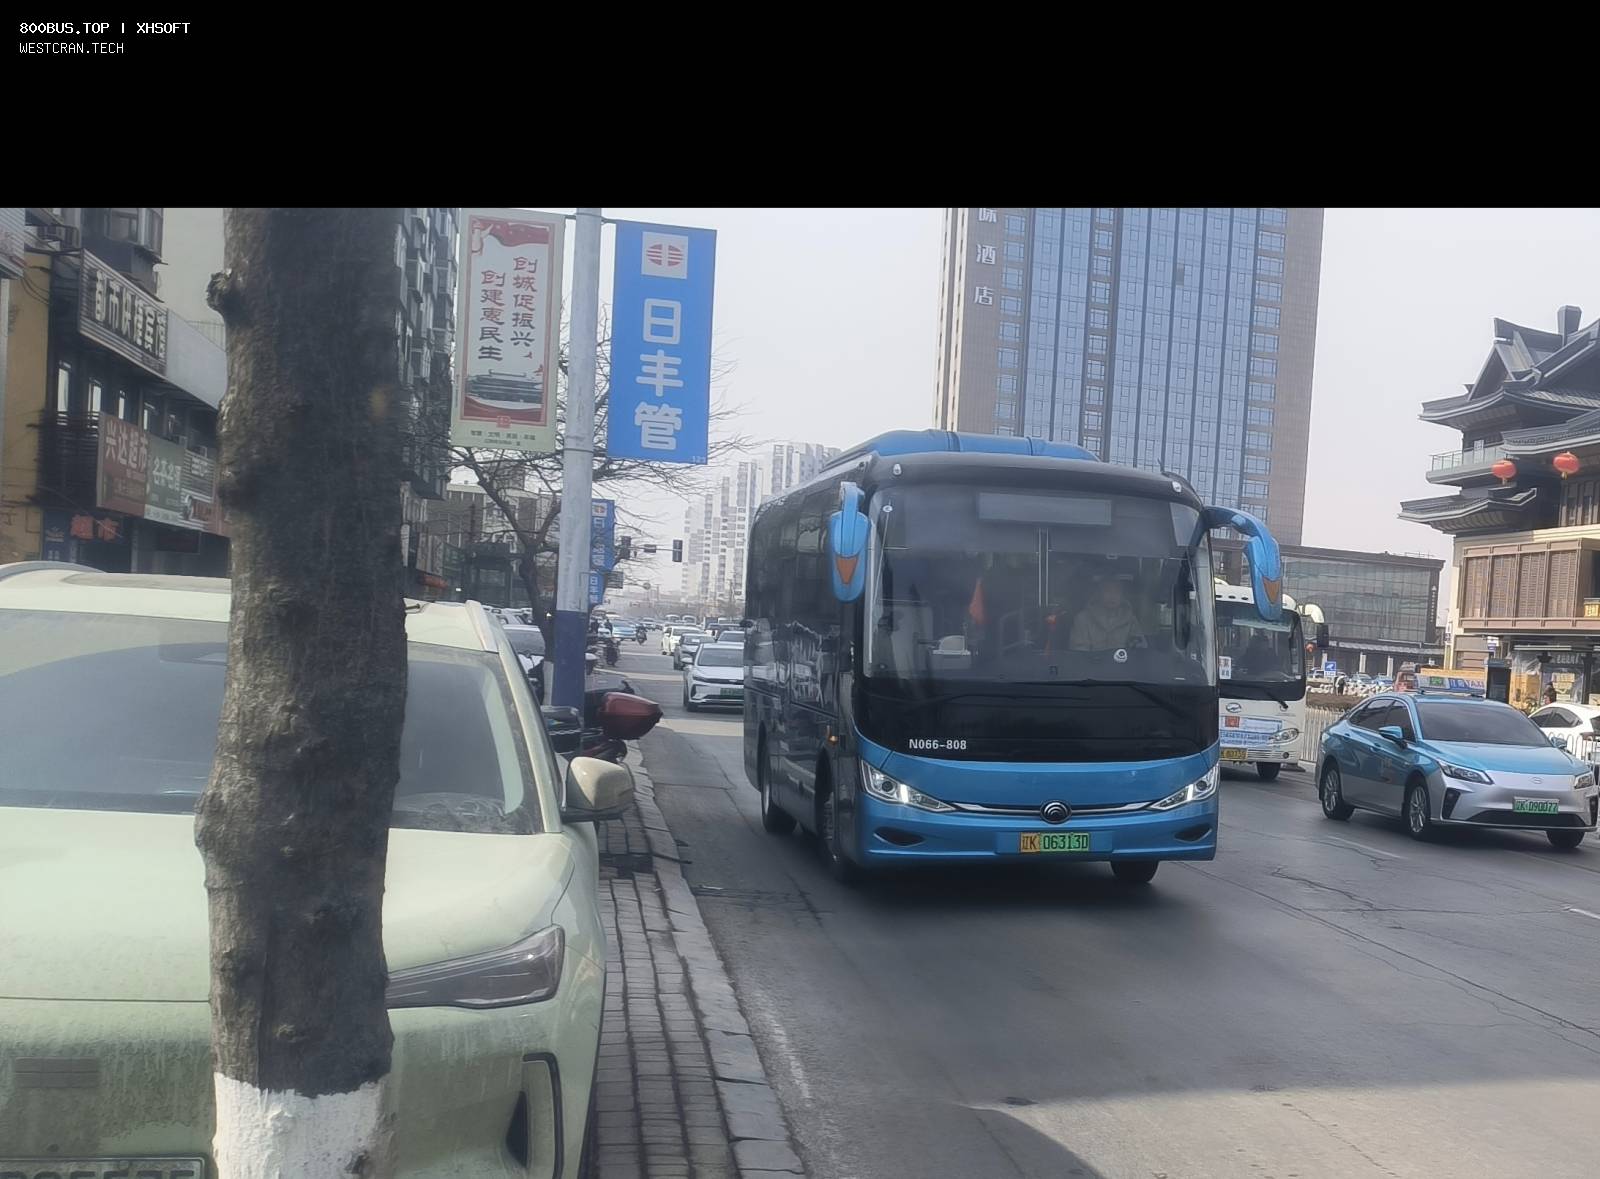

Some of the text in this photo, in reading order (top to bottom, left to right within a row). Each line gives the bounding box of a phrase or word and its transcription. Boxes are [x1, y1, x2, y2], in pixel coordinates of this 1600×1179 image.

[478, 270, 506, 362] 创建惠民生
[510, 256, 538, 348] 创城促振兴
[634, 298, 683, 450] 日丰管
[908, 739, 967, 750] N066-808
